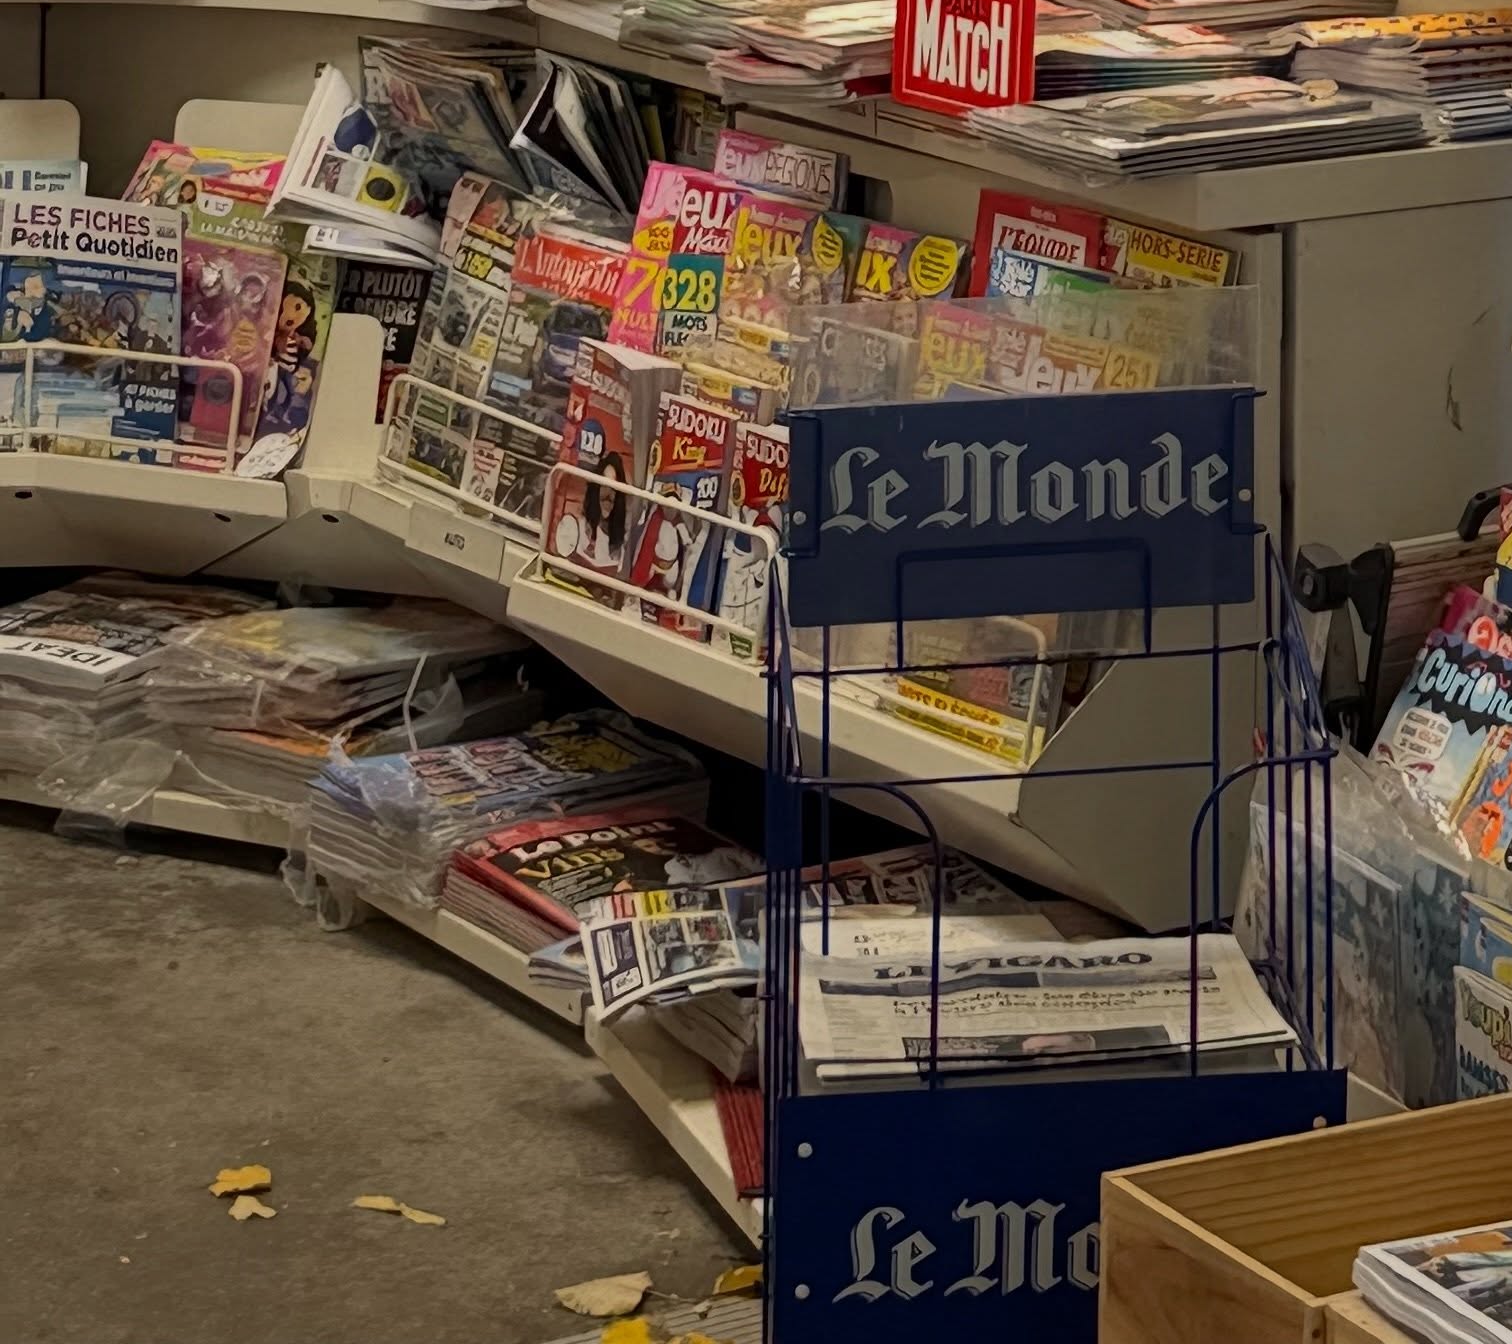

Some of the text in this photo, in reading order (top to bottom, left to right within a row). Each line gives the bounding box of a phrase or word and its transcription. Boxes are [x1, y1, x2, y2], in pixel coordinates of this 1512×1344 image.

[14, 201, 152, 236] LES FICHES
[661, 266, 718, 313] 328
[819, 431, 1230, 535] Le Monde
[830, 1201, 936, 1307] Le
